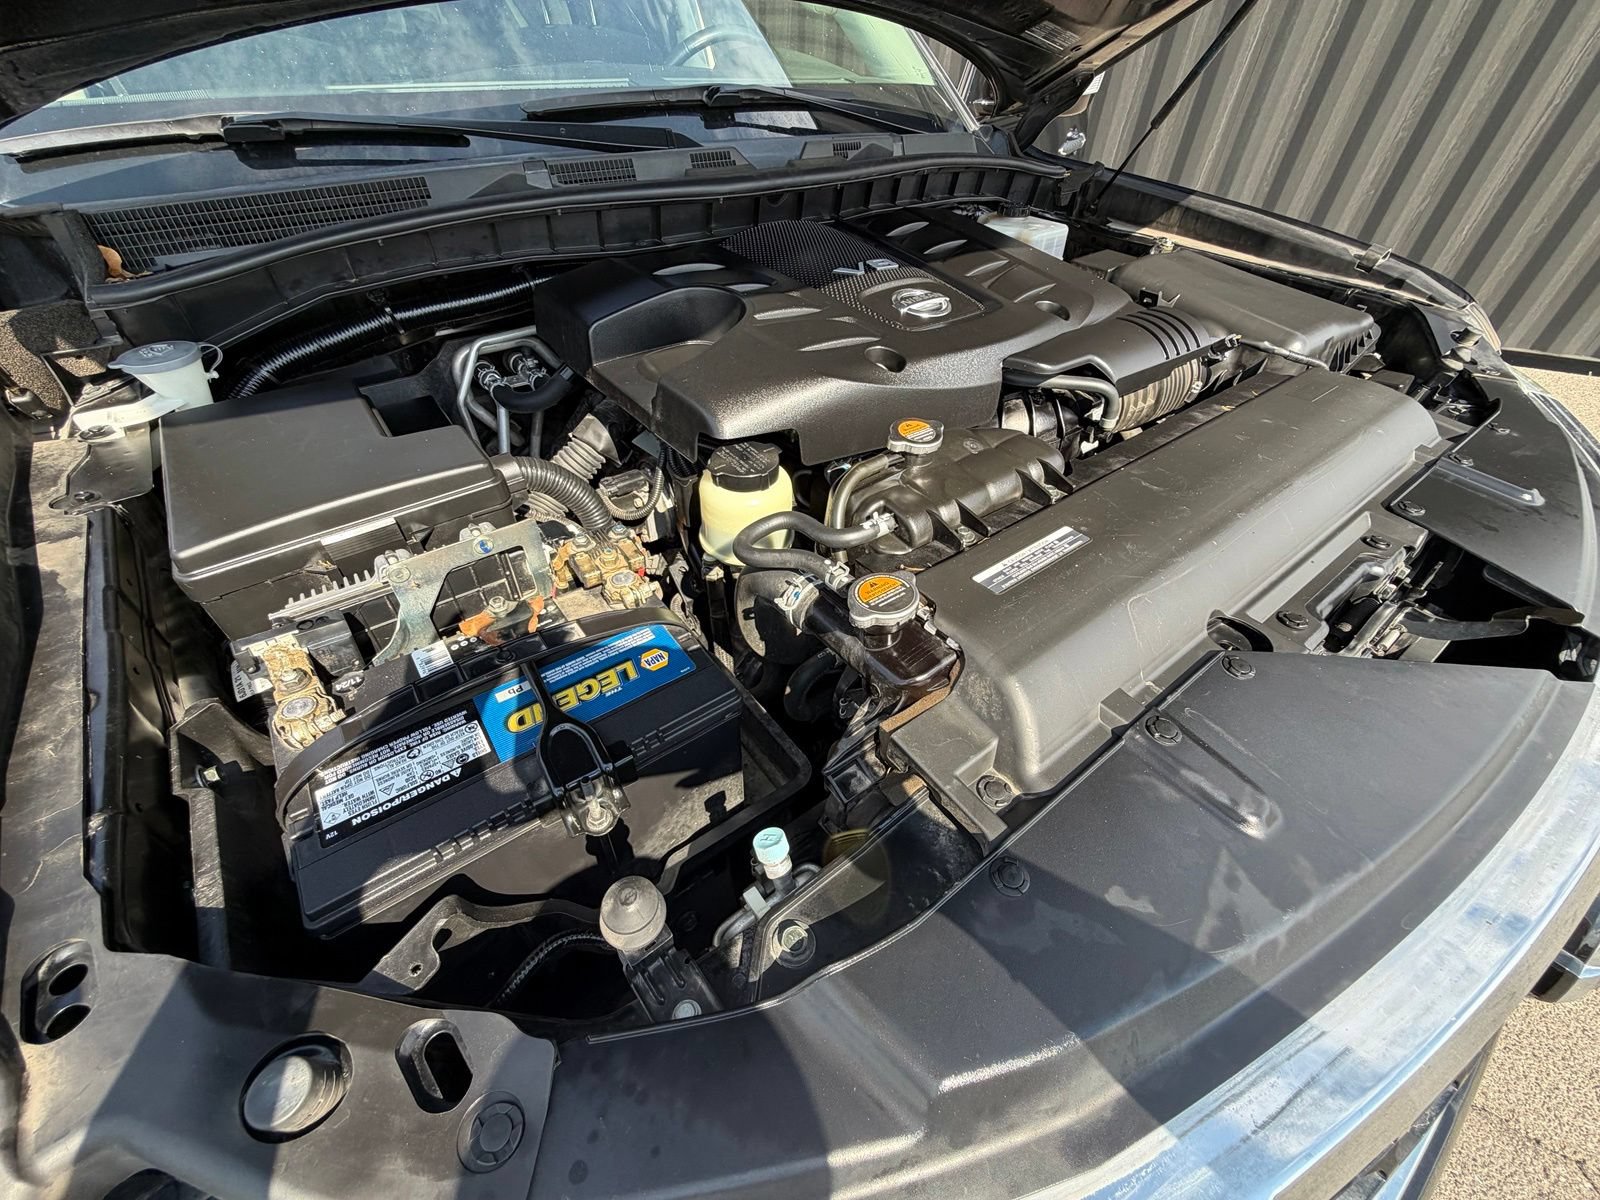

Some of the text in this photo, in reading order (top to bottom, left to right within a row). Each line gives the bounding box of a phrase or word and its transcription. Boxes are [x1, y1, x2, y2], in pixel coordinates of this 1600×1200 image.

[832, 258, 899, 276] V8
[900, 291, 943, 306] NISSAN
[643, 651, 665, 667] NAPA
[335, 675, 361, 690] 11/24
[506, 683, 523, 696] Pb
[604, 685, 622, 697] THE
[410, 725, 430, 737] FOLLOW
[388, 735, 409, 746] PROPER
[361, 744, 388, 758] CHARGING
[377, 745, 406, 761] EXPLOSION
[445, 750, 460, 759] GASES
[404, 774, 416, 783] ACID
[339, 782, 353, 790] OPEN
[334, 790, 347, 799] HELP
[350, 773, 450, 826] DANGER/POISON
[360, 789, 374, 799] WITH
[320, 793, 354, 811] GET MEDICAL
[341, 794, 376, 813] IMMEDIATELY
[360, 798, 377, 809] FLUSH
[324, 829, 337, 839] 12V
